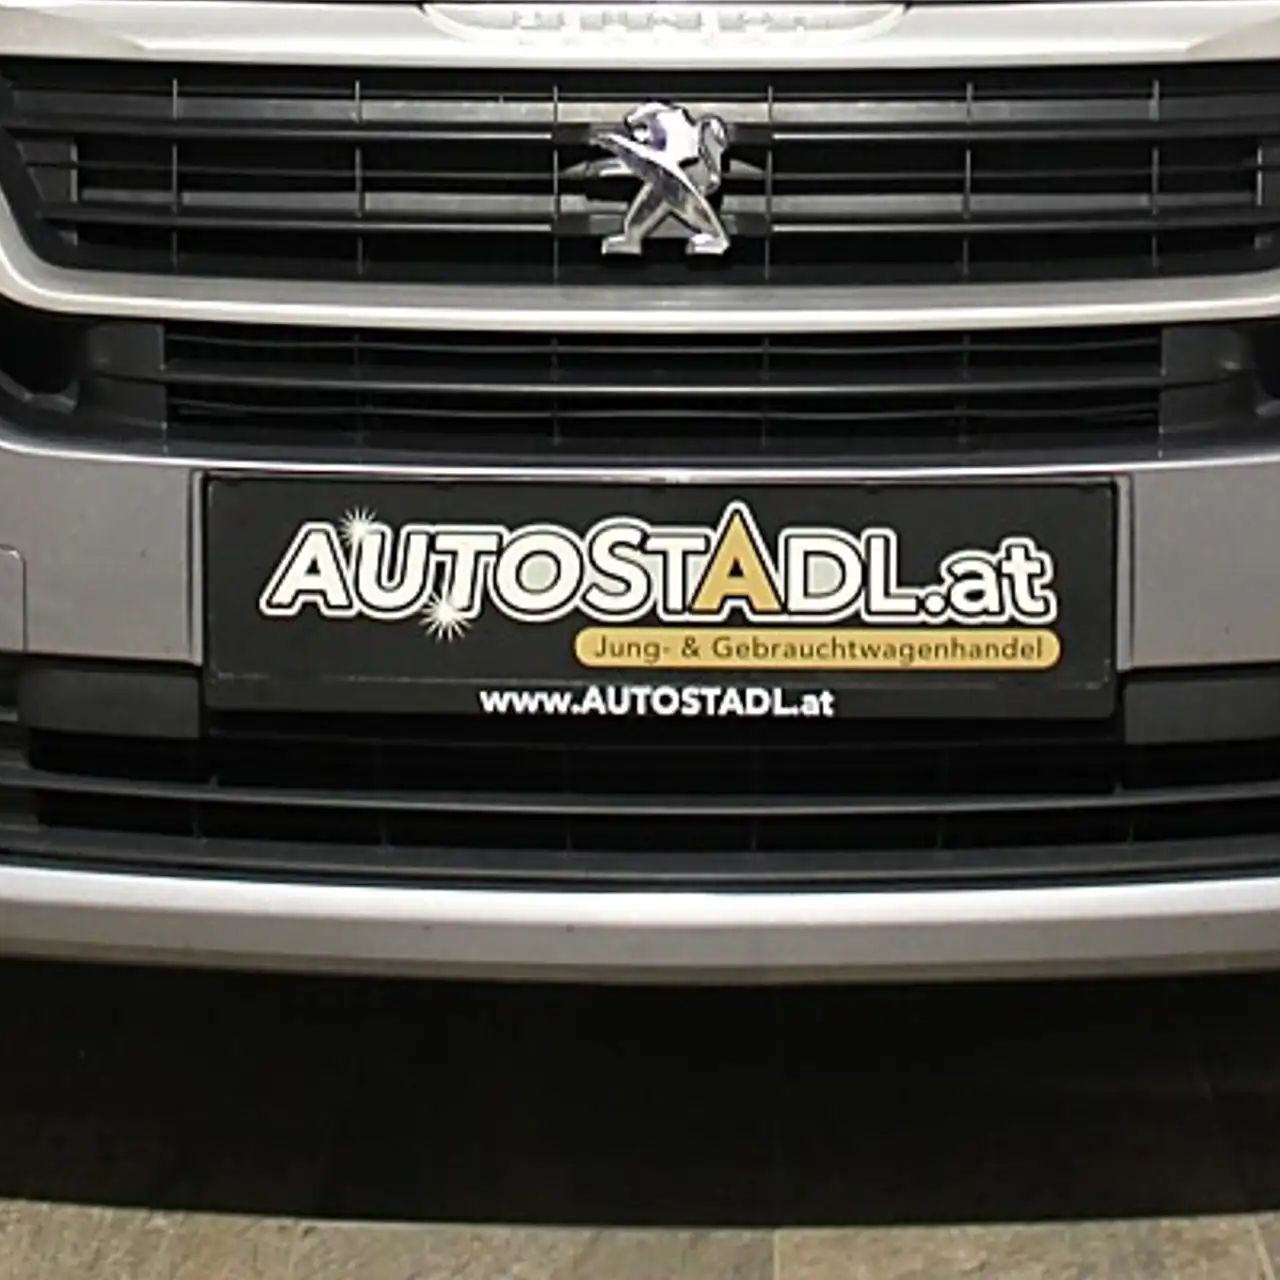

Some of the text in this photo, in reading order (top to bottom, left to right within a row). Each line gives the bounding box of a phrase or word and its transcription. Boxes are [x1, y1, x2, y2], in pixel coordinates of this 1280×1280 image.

[260, 500, 1057, 624] AUTOSTADL.at
[593, 634, 1044, 666] Jung- & Gebrauchtwagenhandel
[479, 685, 835, 716] www.AUTOSTADL.at
